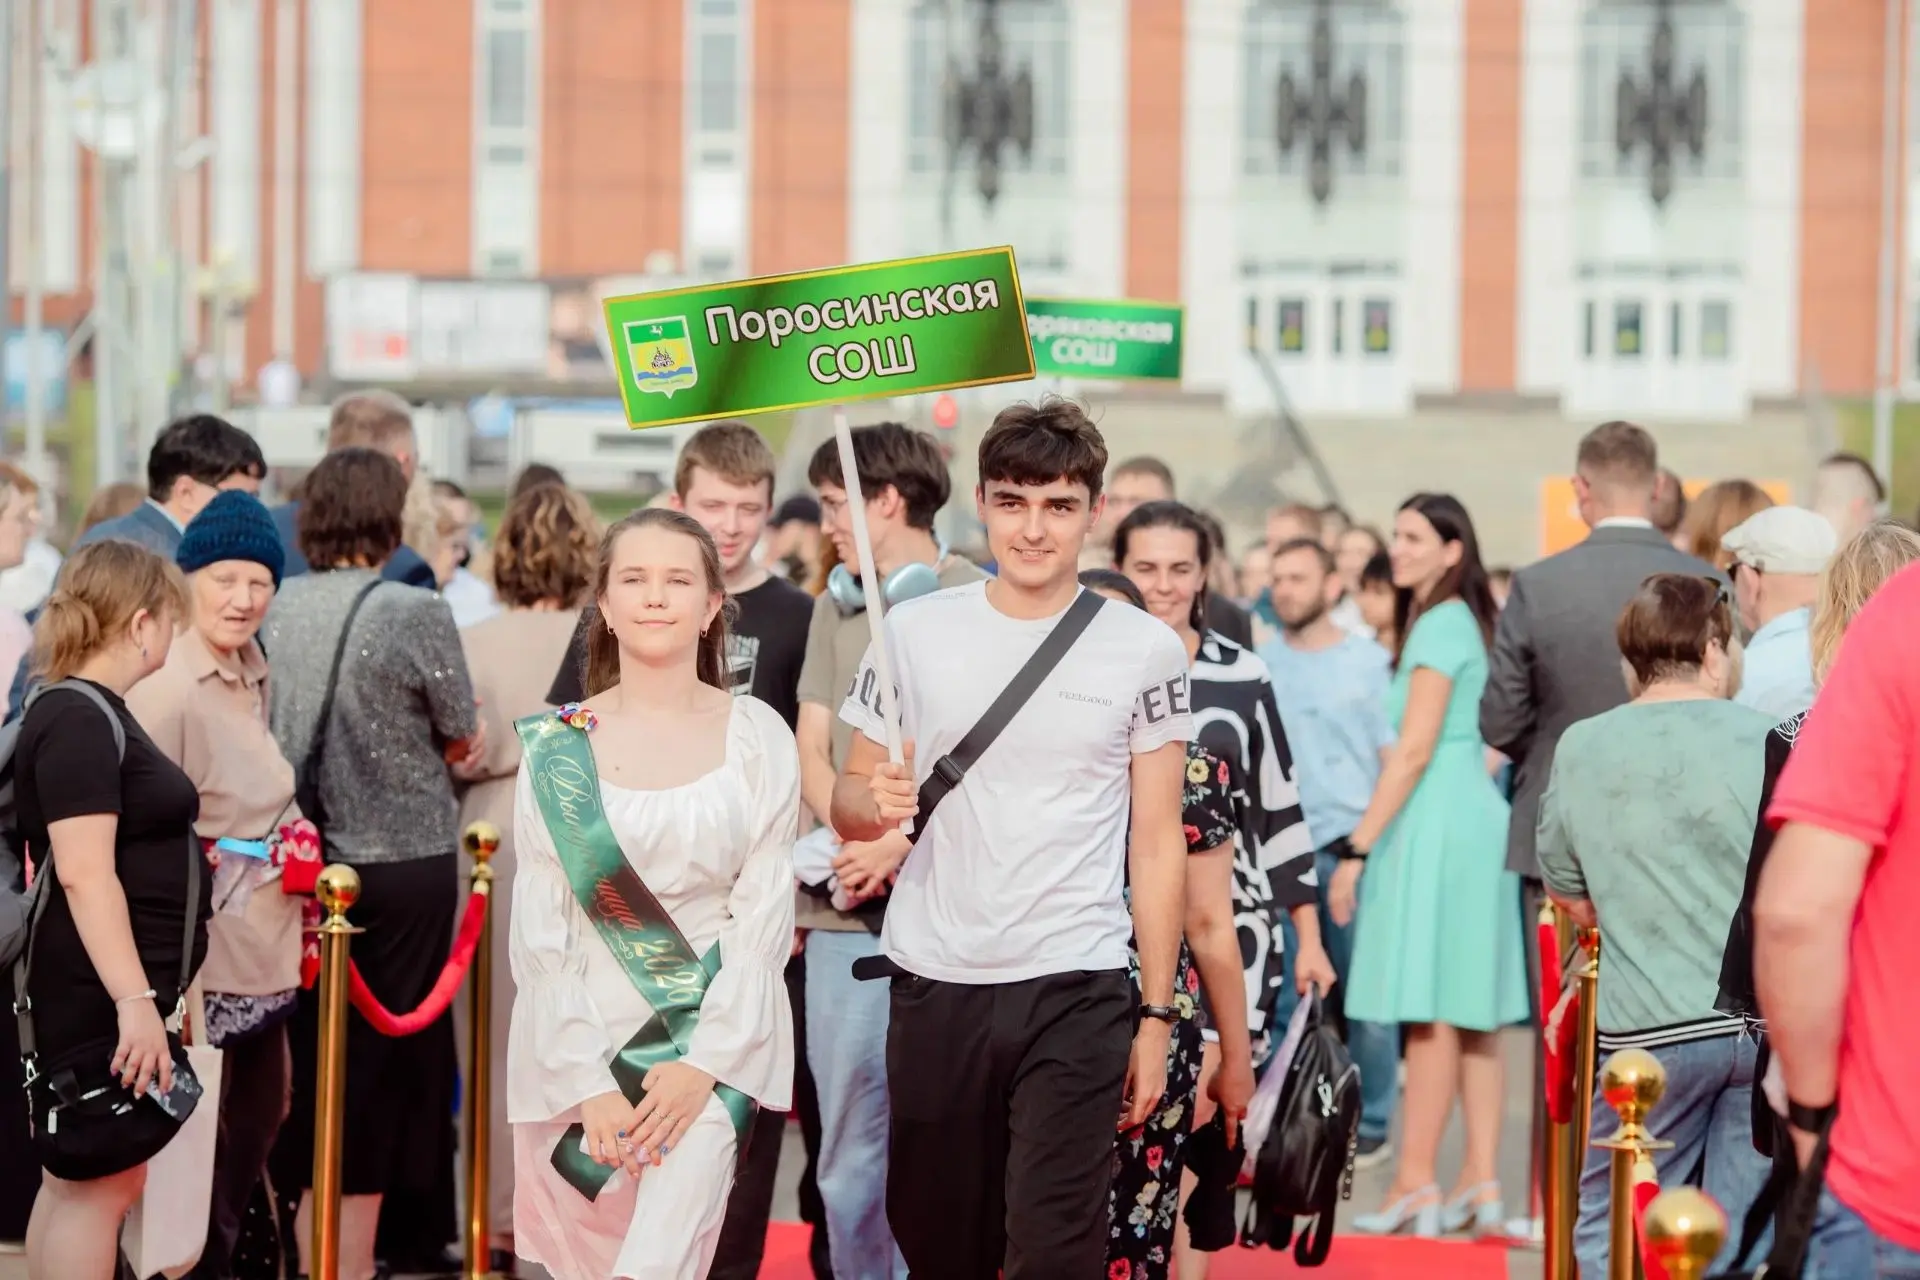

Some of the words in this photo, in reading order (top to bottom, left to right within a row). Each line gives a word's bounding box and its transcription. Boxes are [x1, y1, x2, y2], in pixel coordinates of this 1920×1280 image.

[704, 278, 1000, 348] Поросинская
[1027, 314, 1174, 344] оряковская
[808, 334, 917, 384] СОШ
[1051, 337, 1118, 367] СОШ
[1058, 690, 1113, 707] FEELGOOD
[545, 755, 644, 932] Выпуница
[628, 939, 705, 1003] 2026
